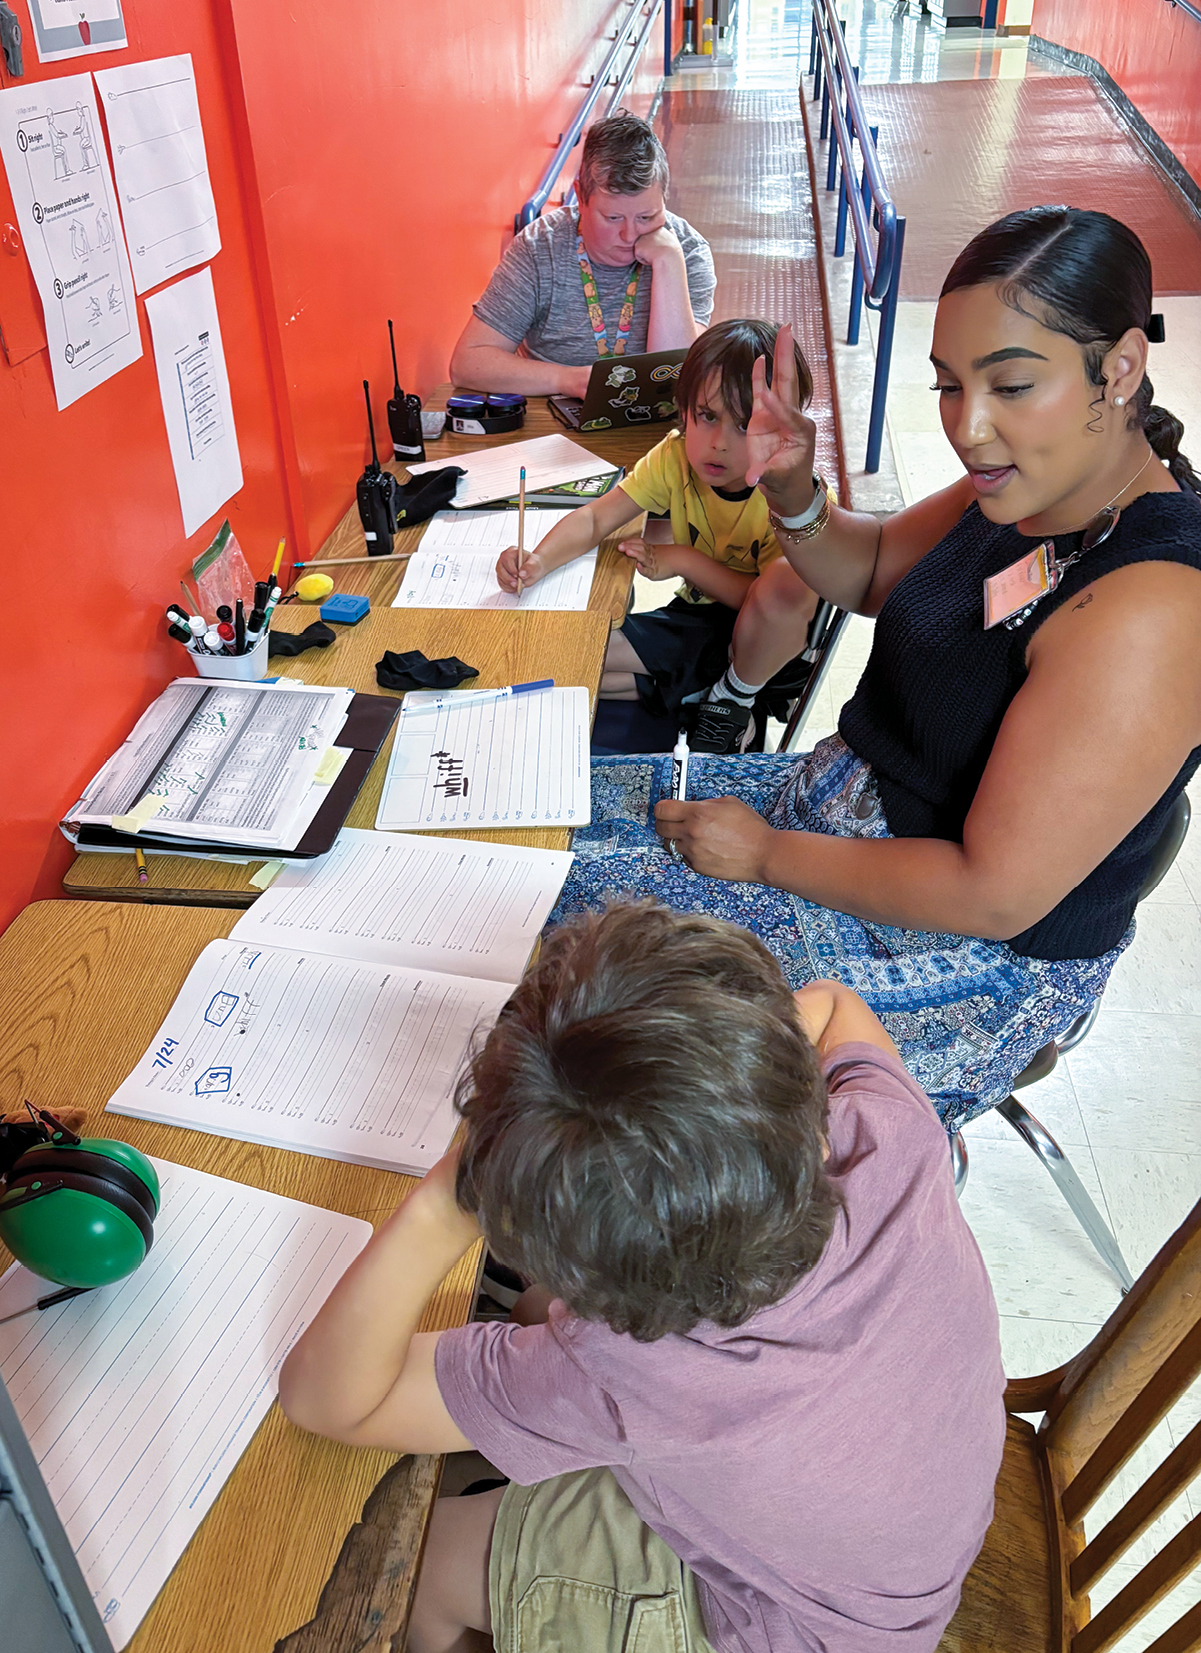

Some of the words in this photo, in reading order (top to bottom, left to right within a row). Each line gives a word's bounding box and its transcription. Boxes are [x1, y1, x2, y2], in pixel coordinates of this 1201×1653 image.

[19, 134, 25, 148] 1
[35, 207, 42, 221] 2
[55, 282, 62, 296] 3
[433, 758, 463, 798] whiff
[152, 1037, 180, 1069] 7/24
